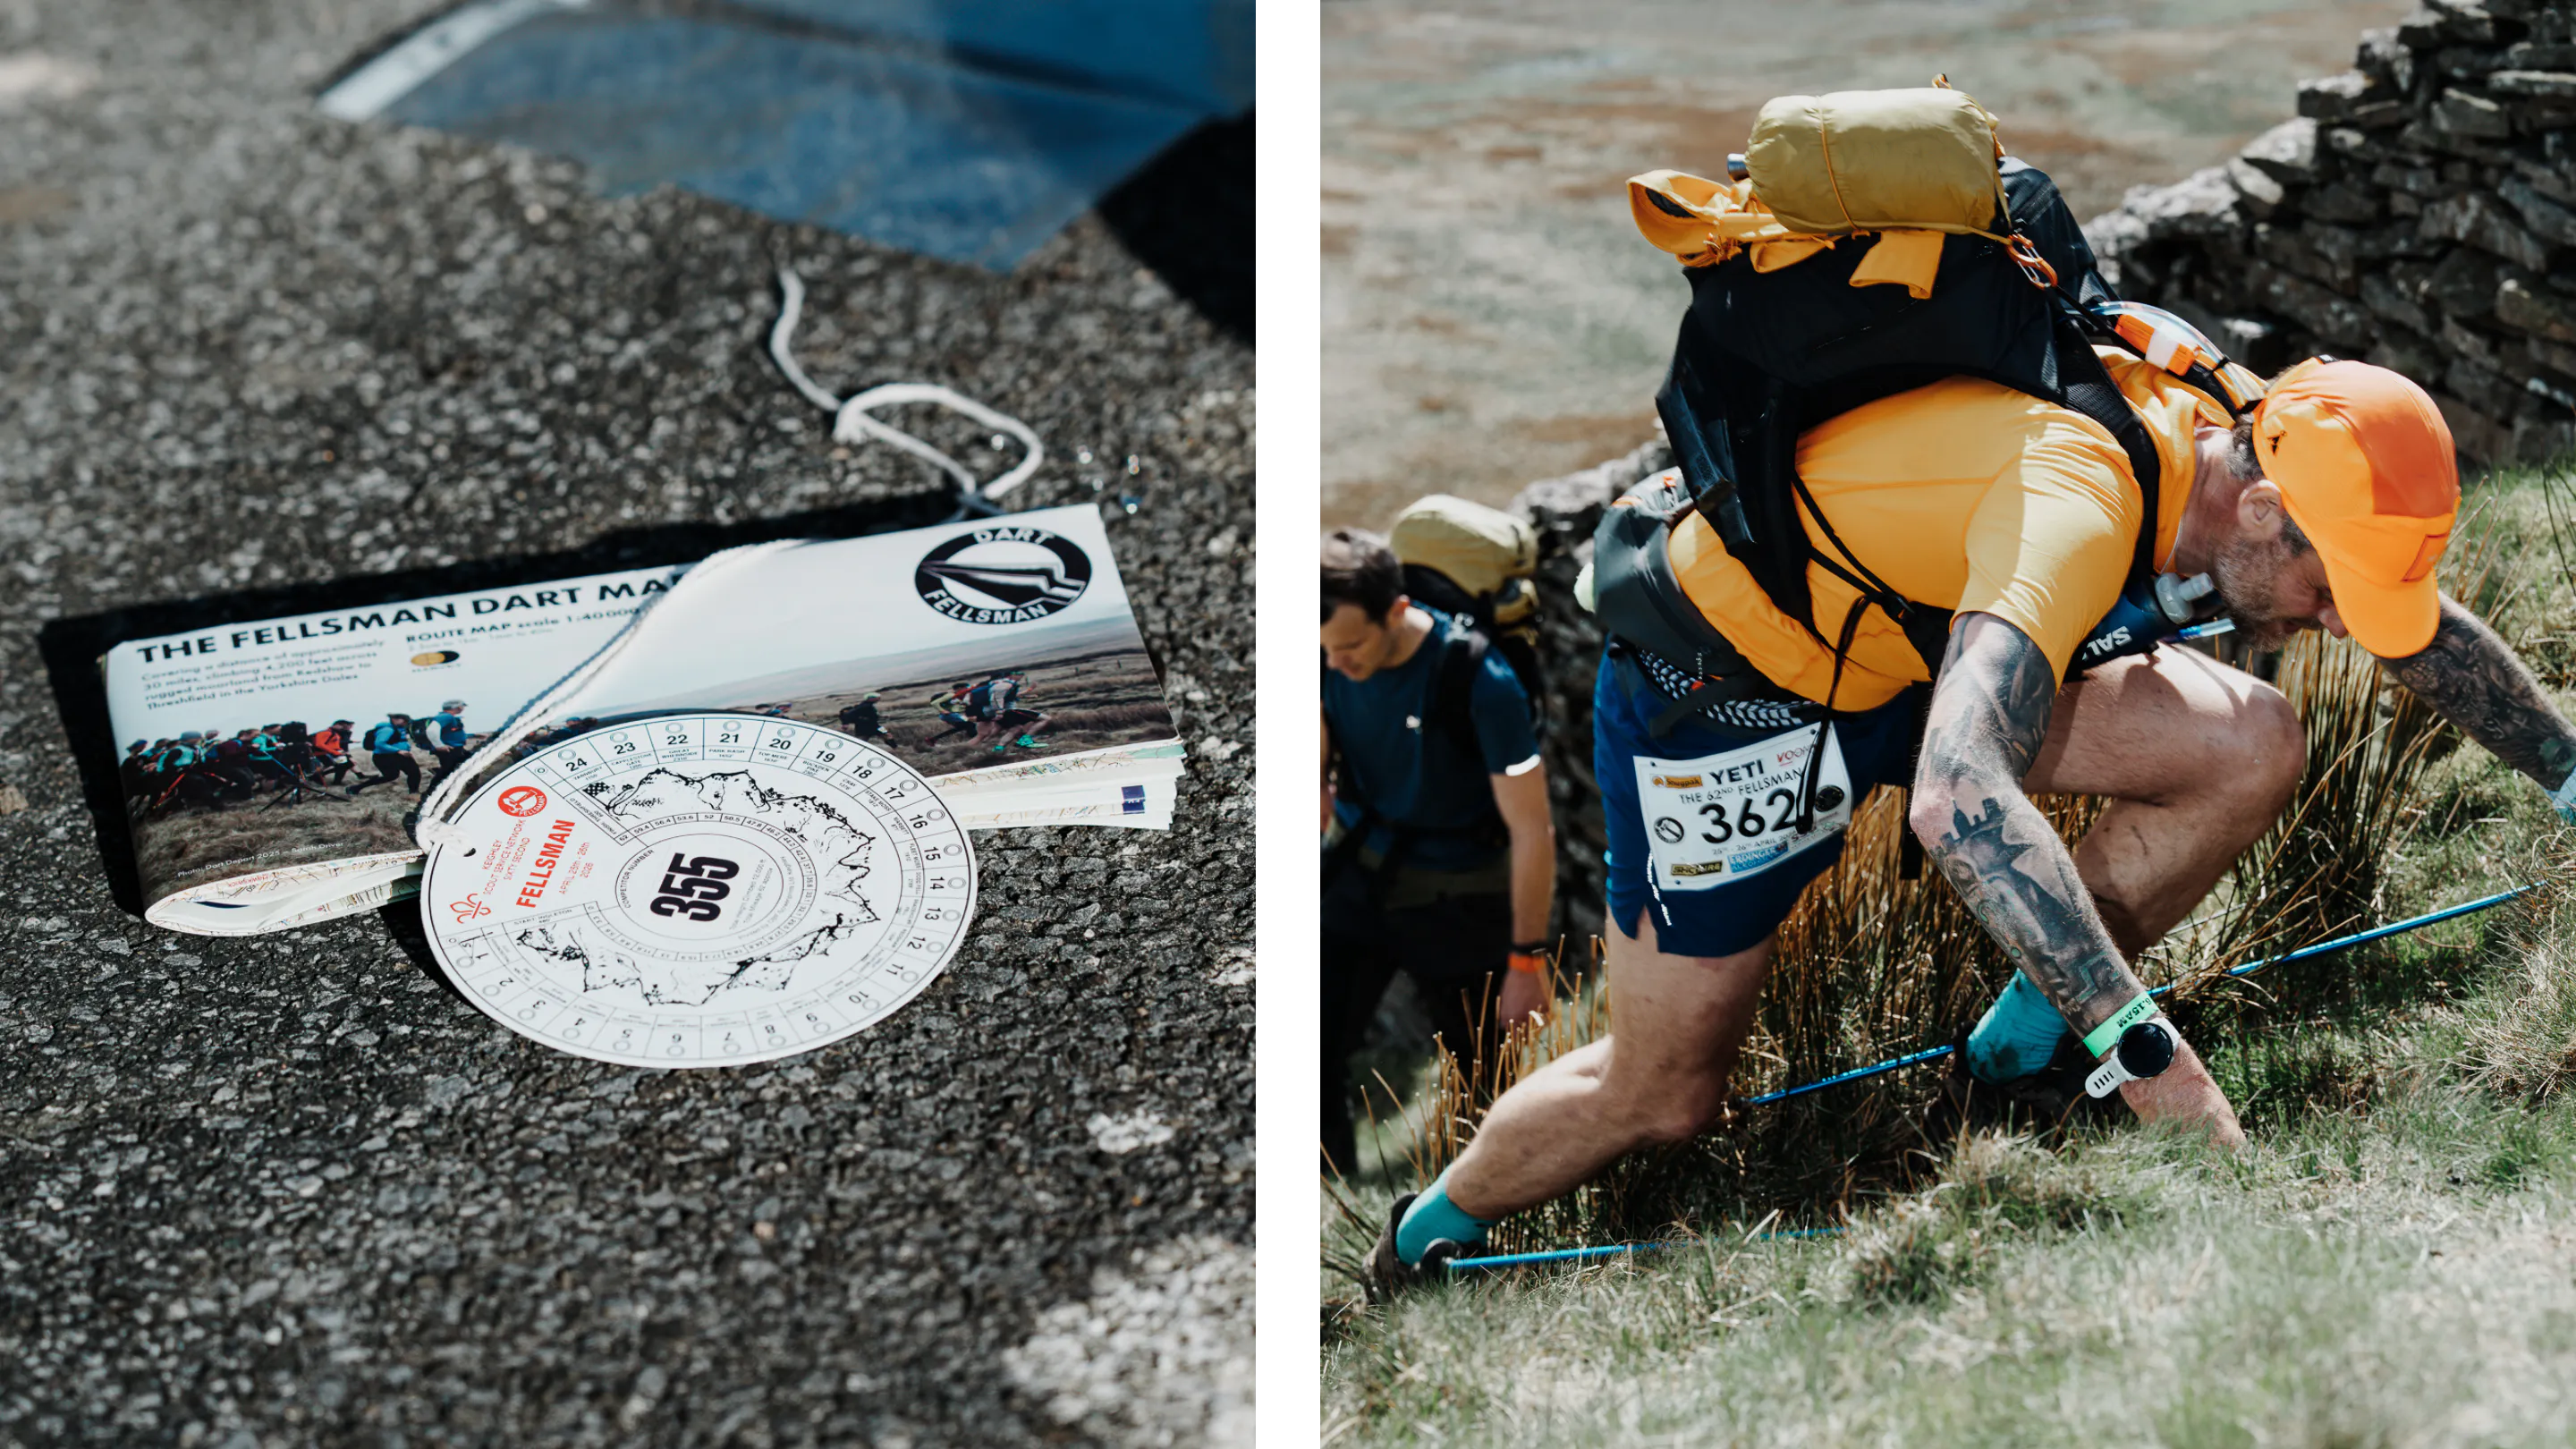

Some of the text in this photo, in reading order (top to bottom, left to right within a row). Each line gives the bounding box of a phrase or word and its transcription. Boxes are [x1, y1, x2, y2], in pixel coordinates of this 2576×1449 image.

[973, 527, 1055, 545] DART
[924, 589, 1048, 623] FELLSMAN
[137, 637, 217, 663] THE
[231, 602, 456, 648] FELLSMAN
[472, 587, 581, 614] DART
[406, 629, 464, 642] ROUTE
[471, 623, 511, 634] MAP
[518, 618, 559, 628] scale
[2082, 625, 2132, 661] SAL
[142, 667, 200, 680] Covering
[206, 668, 260, 680] climbing
[145, 686, 191, 700] rugged
[196, 676, 258, 691] moorland
[258, 679, 318, 691] Yorkshire
[322, 674, 358, 682] Dales
[666, 733, 689, 745] 22
[719, 733, 740, 744] 21
[769, 738, 792, 750] 20
[614, 741, 636, 755] 23
[815, 750, 836, 763] 19
[565, 758, 587, 772] 24
[852, 765, 873, 779] 18
[1708, 758, 1764, 785] YETI
[1666, 778, 1699, 787] Snugpak
[1679, 767, 1803, 804] THE 62ND FELLSMAN
[884, 786, 905, 801] 17
[518, 795, 547, 816] FELLSMAN
[655, 818, 672, 826] 56.4
[909, 814, 928, 829] 16
[1698, 788, 1797, 843] 362
[633, 825, 649, 834] 59.4
[1755, 838, 1776, 847] APRIL
[482, 839, 503, 870] KEIGHLEY
[483, 818, 526, 895] SCOUT SERVICE NETWORK
[504, 837, 530, 880] SIXTY SECOND
[924, 846, 942, 861] 15
[177, 868, 203, 877] Photo:
[205, 861, 225, 869] Dart
[225, 855, 256, 867] Depart
[516, 819, 575, 908] FELLSMAN
[559, 875, 573, 894] APRIL
[619, 849, 655, 909] COMPETITOR NUMBER
[929, 876, 945, 890] 14
[650, 852, 740, 922] 355
[924, 907, 942, 920] 13
[907, 936, 926, 950] 12
[886, 963, 904, 976] 11
[499, 978, 514, 987] 2
[849, 990, 869, 1004] 10
[532, 1000, 546, 1010] 3
[2116, 997, 2152, 1028] 6.15AM
[575, 1018, 586, 1026] 4
[765, 1024, 776, 1034] 8
[622, 1029, 633, 1038] 5
[724, 1031, 732, 1041] 7
